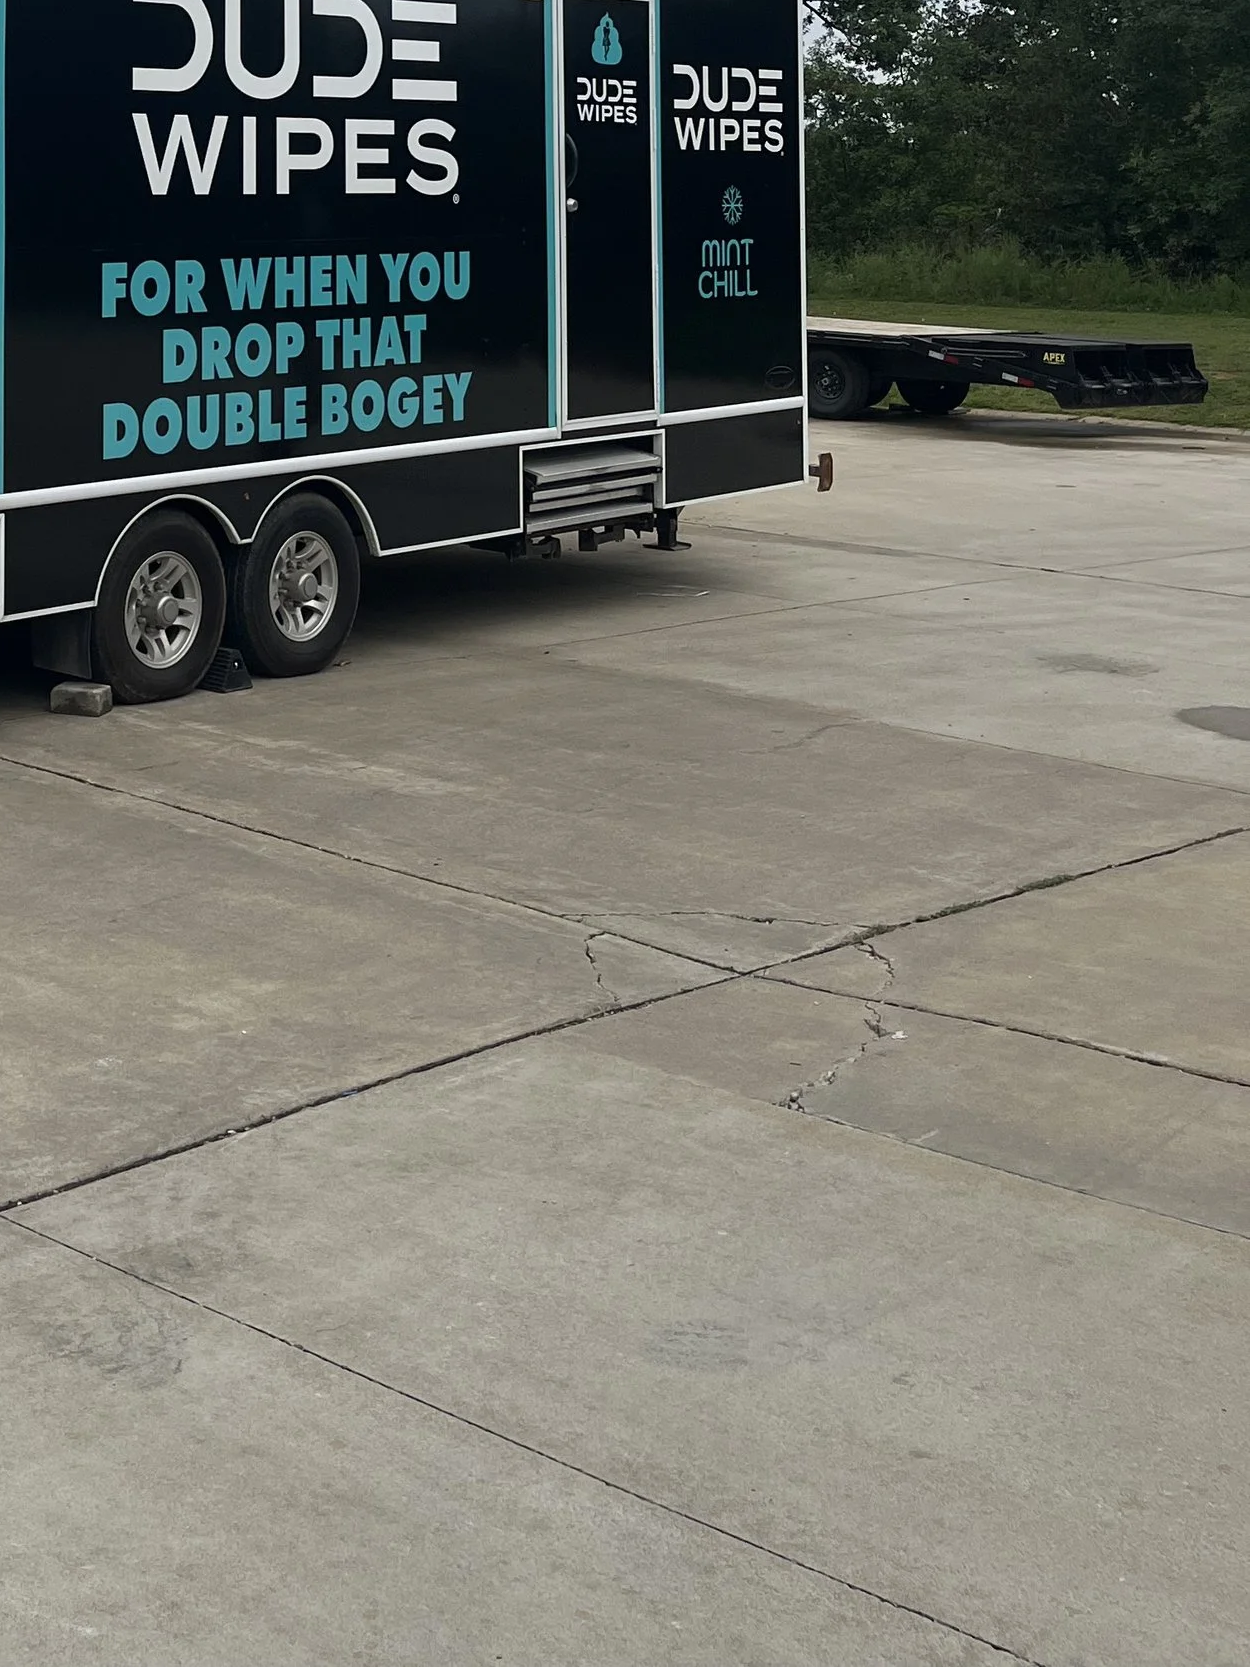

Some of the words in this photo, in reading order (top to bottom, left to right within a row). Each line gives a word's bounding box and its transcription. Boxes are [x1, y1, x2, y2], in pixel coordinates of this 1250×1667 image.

[576, 77, 637, 103] DUDE
[673, 64, 784, 113] DUDE
[576, 103, 638, 124] WIPES
[132, 113, 460, 196] WIPES
[673, 117, 785, 153] WIPES
[102, 260, 208, 318] FOR
[220, 254, 367, 311] WHEN
[379, 251, 471, 303] YOU
[698, 269, 758, 299] CHILL
[162, 322, 305, 384] DROP
[315, 314, 427, 371] THAT
[1043, 352, 1066, 363] APEX
[103, 386, 307, 460] DOUBLE
[321, 371, 473, 436] BOGEY
